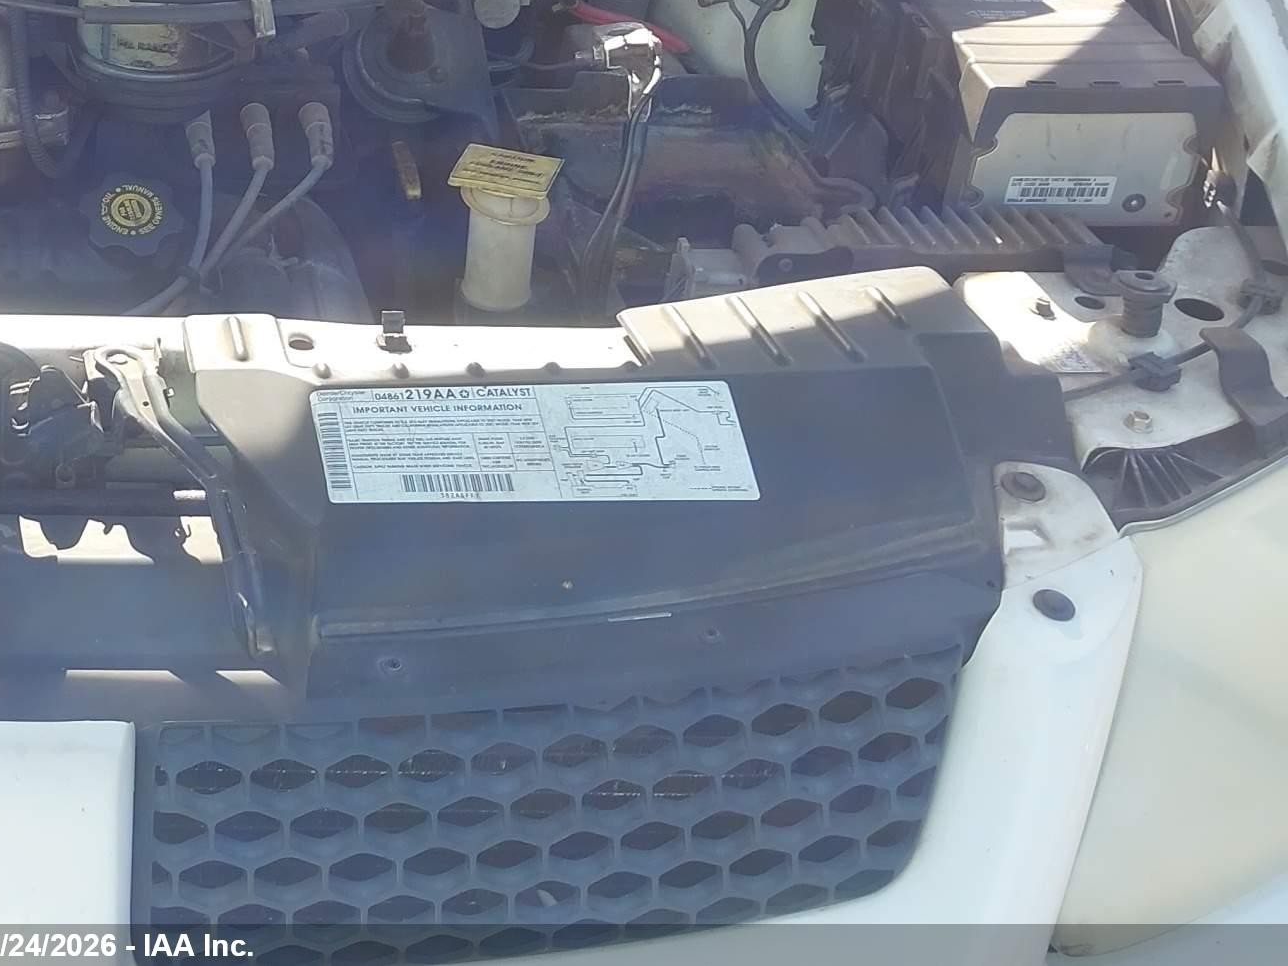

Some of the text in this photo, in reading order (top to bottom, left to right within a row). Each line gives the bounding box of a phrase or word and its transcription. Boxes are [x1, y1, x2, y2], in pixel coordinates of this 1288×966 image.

[121, 184, 155, 197] MANUAL
[101, 215, 129, 235] ENGINE
[476, 388, 531, 397] CATALYST
